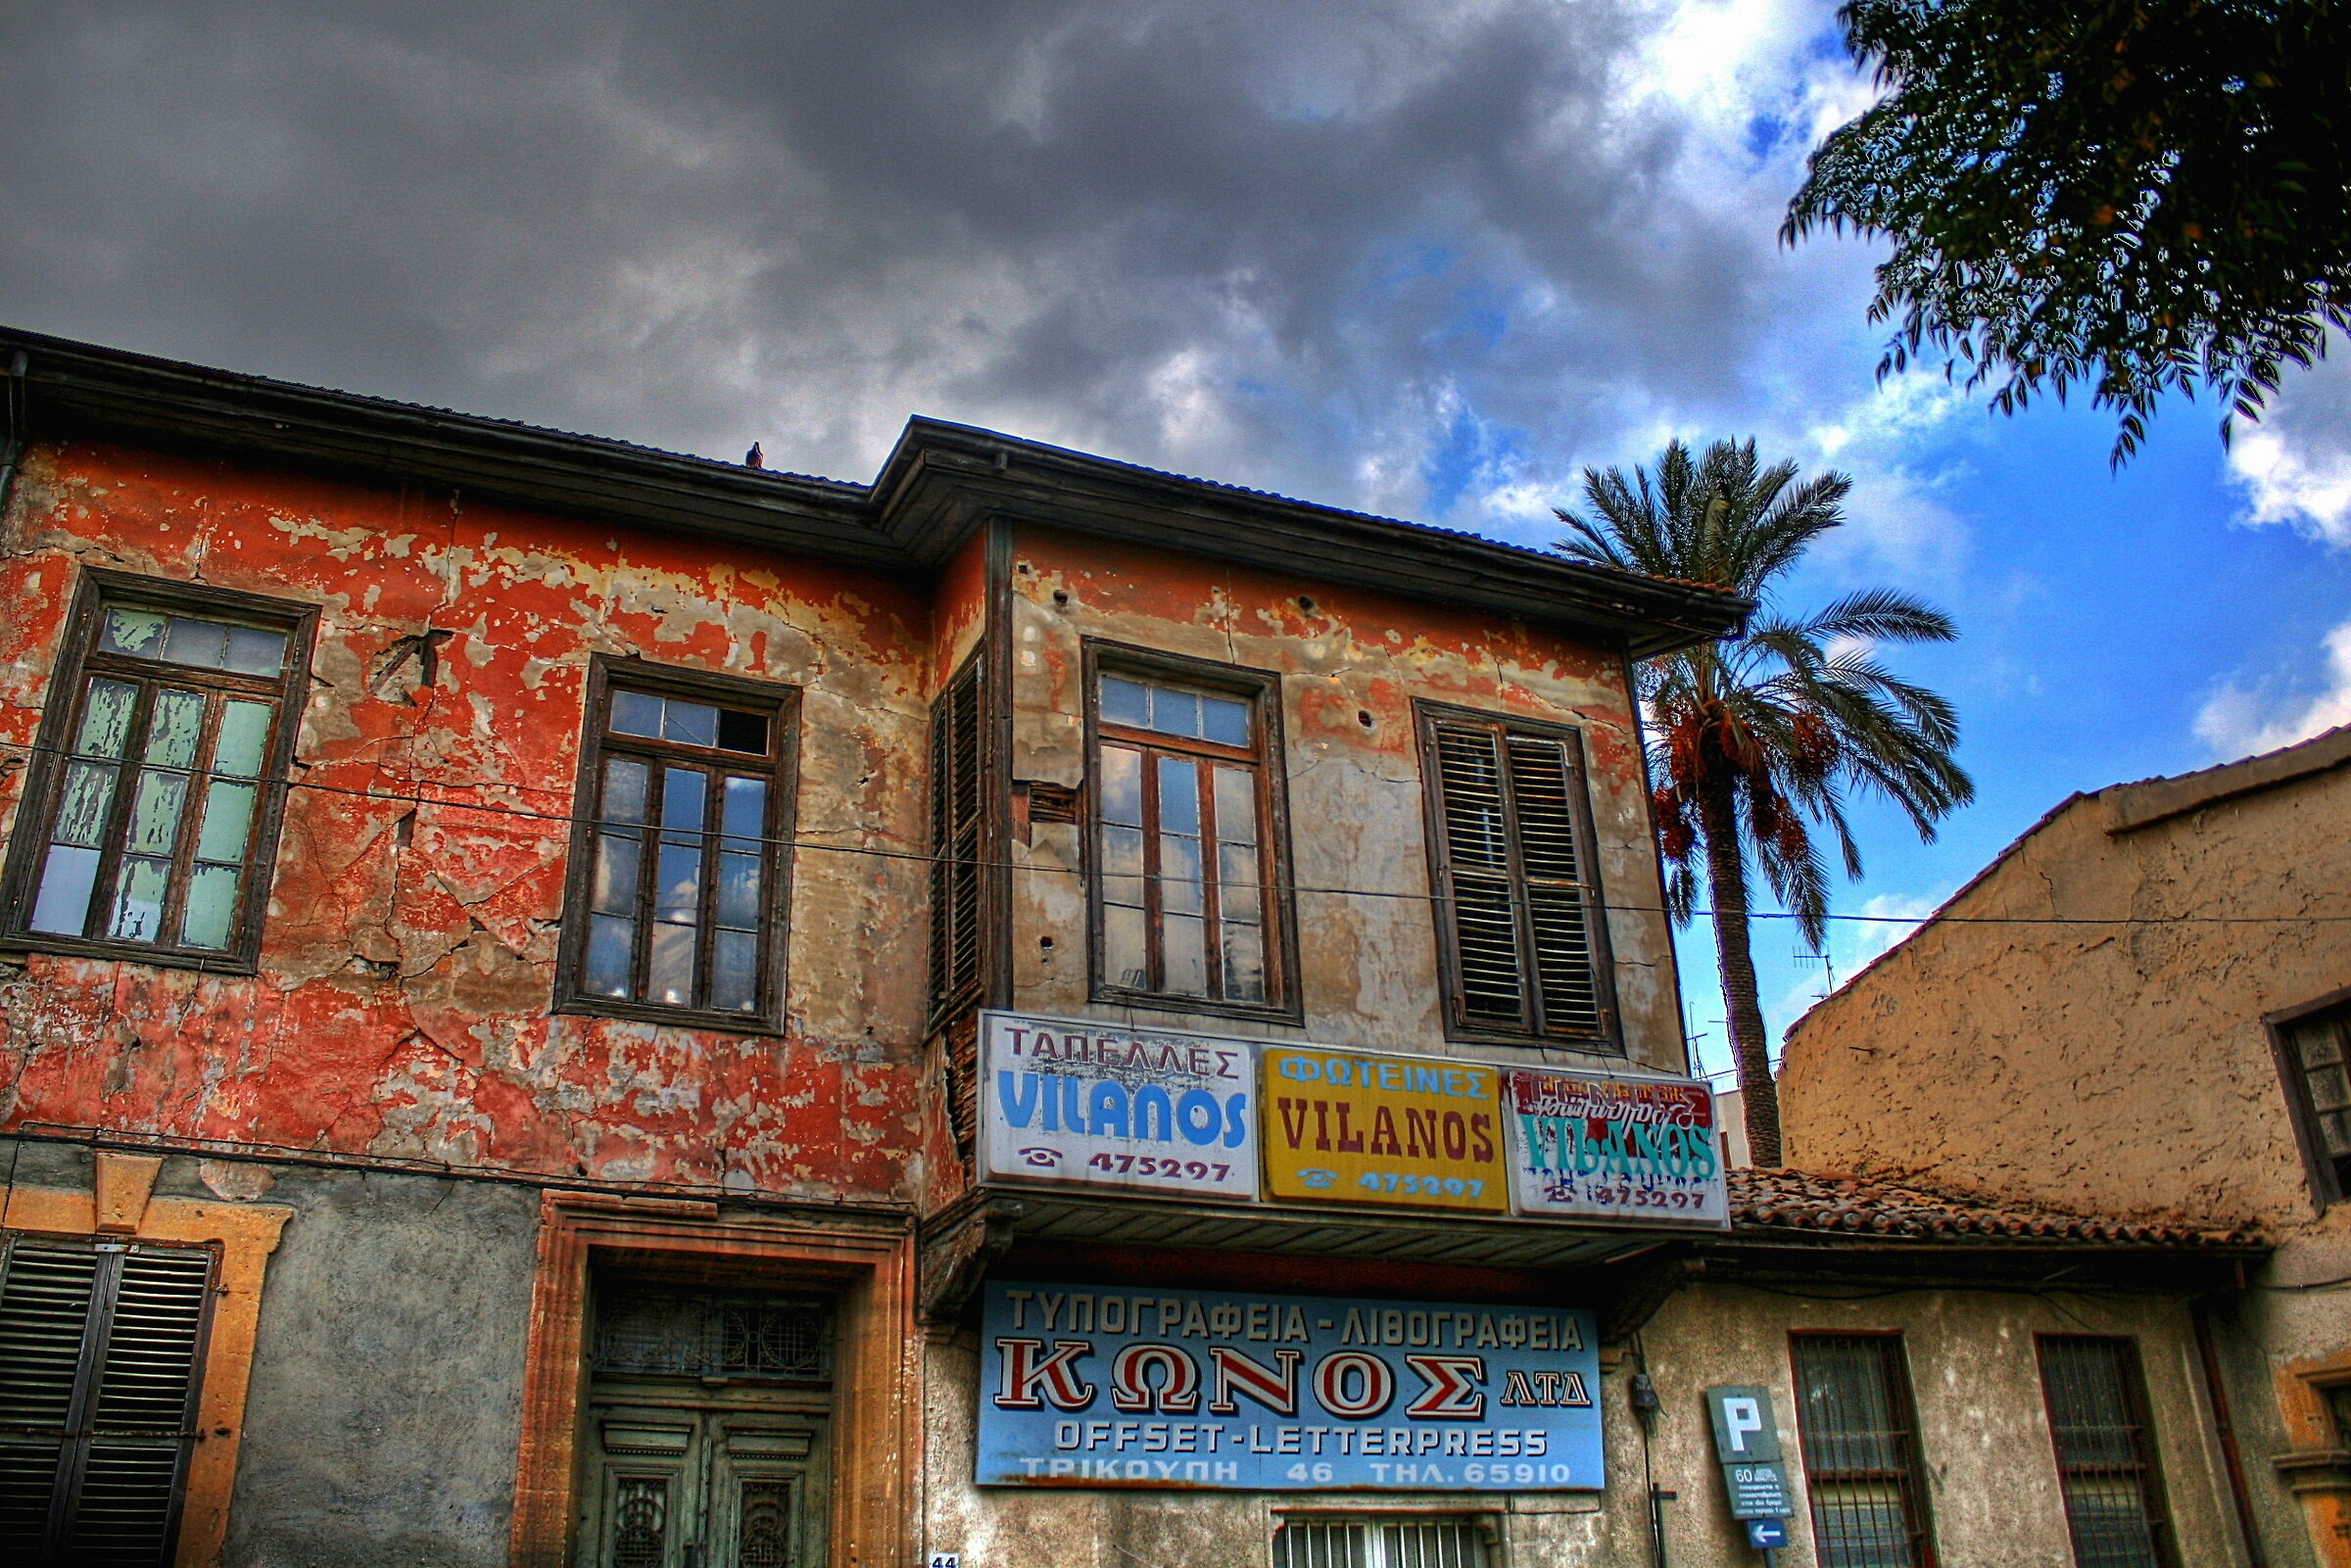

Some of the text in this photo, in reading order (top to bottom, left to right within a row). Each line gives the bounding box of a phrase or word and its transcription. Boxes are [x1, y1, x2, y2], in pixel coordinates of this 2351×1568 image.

[1004, 1027, 1239, 1079] ΤΑΠΕΛΛΕΣ
[1279, 1056, 1490, 1100] ΦΩΤΕΙΝΕΣ
[997, 1069, 1247, 1149] VILANOS
[1277, 1096, 1494, 1163] VILANOS
[1088, 1153, 1231, 1182] 475297
[1519, 1115, 1715, 1179] VILANOS
[1359, 1172, 1485, 1199] 475297
[1595, 1187, 1704, 1209] 475297
[1007, 1290, 1309, 1343] ΤΥΠΟΓΡΑΦΕΙΑ
[1341, 1307, 1584, 1351] ΛΙΘΟΓΡΑΦΕΙΑ
[992, 1337, 1592, 1420] ΚΩΝΟΣ ΛΤΔ
[1723, 1398, 1762, 1451] P
[1019, 1456, 1238, 1482] ΤΡΙΚΟΥΠΗ
[1285, 1462, 1333, 1484] 46
[1464, 1463, 1571, 1485] 65910
[1735, 1469, 1752, 1483] 60
